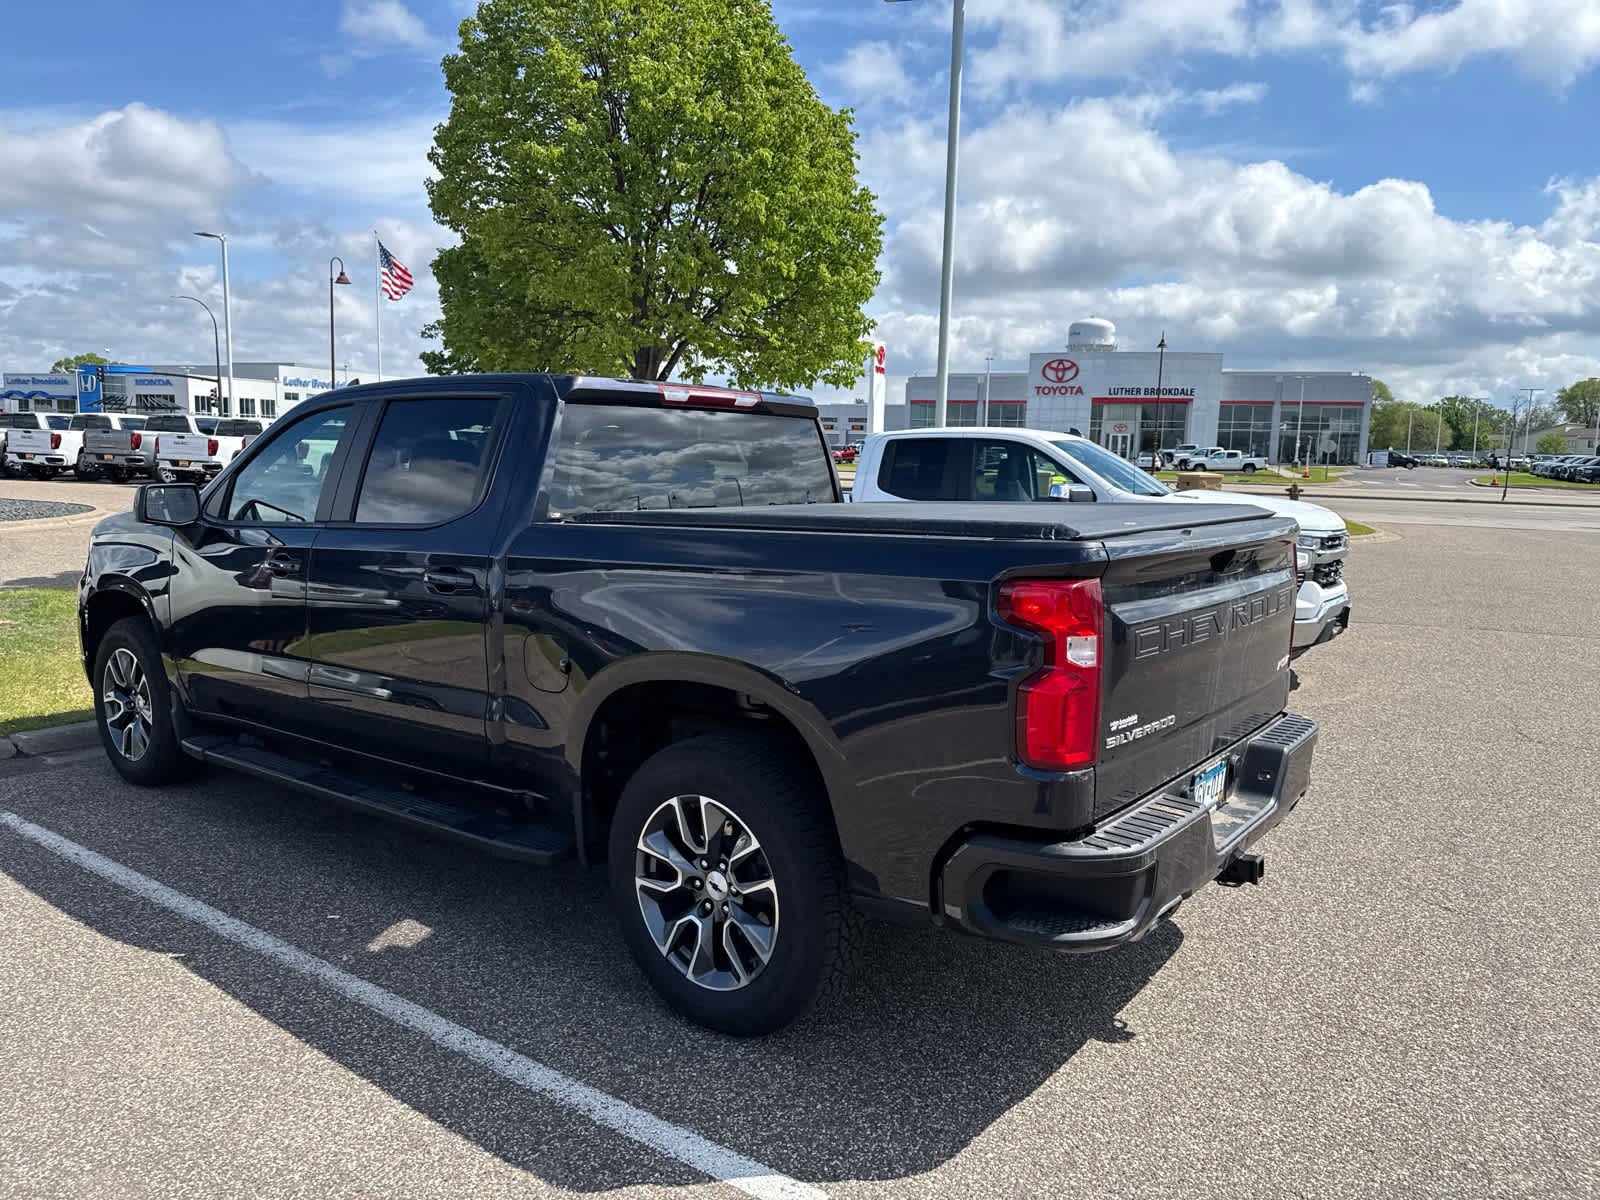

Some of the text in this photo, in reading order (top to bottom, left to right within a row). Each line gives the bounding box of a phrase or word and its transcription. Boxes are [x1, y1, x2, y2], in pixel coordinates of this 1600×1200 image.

[283, 376, 311, 387] Luther
[1034, 386, 1084, 396] TOYOTA
[1108, 387, 1196, 397] LUTHER BROOKDALE
[1134, 585, 1296, 660] CHEVROLET
[1105, 714, 1176, 749] SILVERADO
